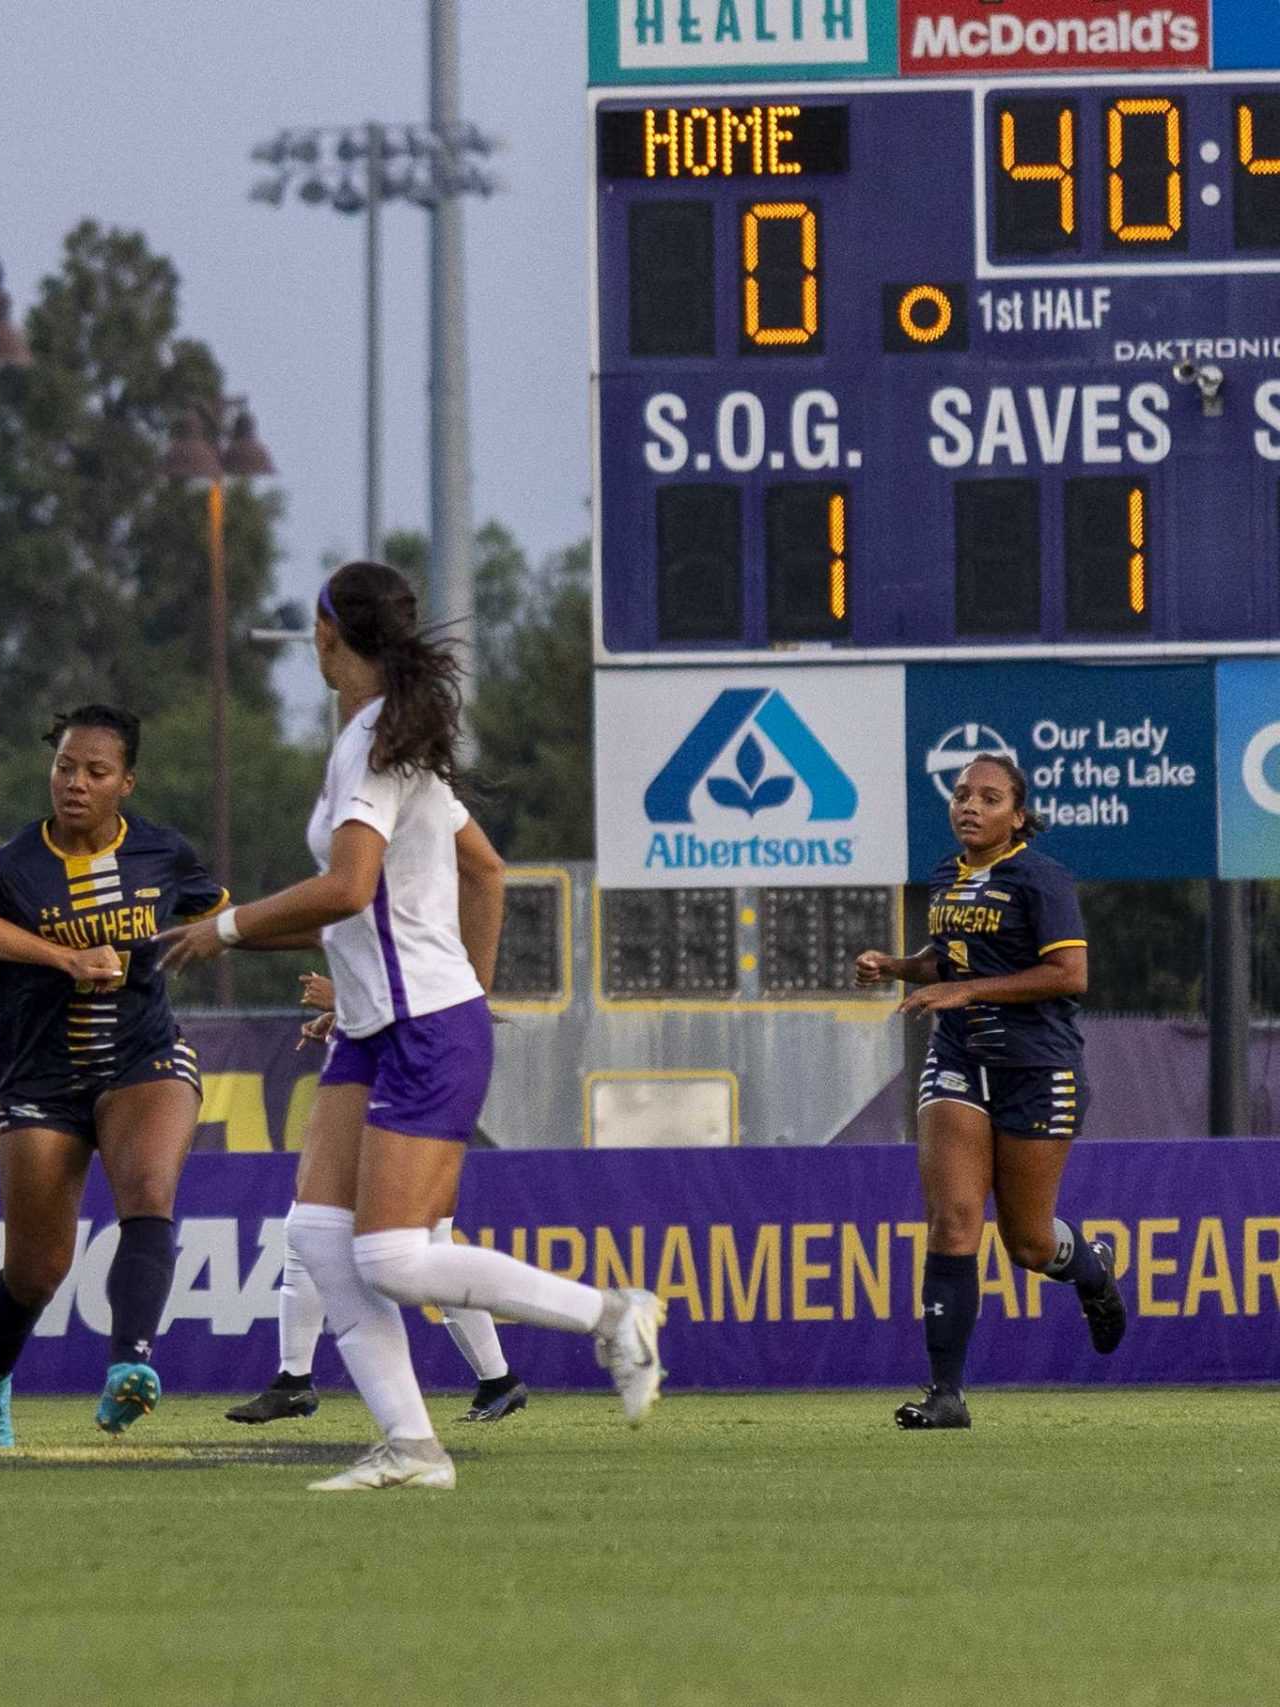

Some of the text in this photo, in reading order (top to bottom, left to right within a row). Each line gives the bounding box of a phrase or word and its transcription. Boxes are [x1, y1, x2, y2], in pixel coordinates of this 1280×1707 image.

[635, 0, 852, 44] HEALTH
[911, 12, 1199, 58] McDonald's
[645, 105, 801, 177] HOME
[743, 203, 816, 345] 0
[978, 288, 1111, 332] 1st HALF
[644, 391, 863, 473] S.O.G.
[929, 383, 1172, 467] SAVES
[829, 494, 846, 619] 1
[1128, 488, 1145, 614] 1
[1032, 718, 1168, 755] Our Lady
[1034, 756, 1195, 787] of the Lake
[1034, 795, 1128, 826] Health
[644, 832, 853, 868] Albertsons
[928, 905, 1003, 936] OUTHERN
